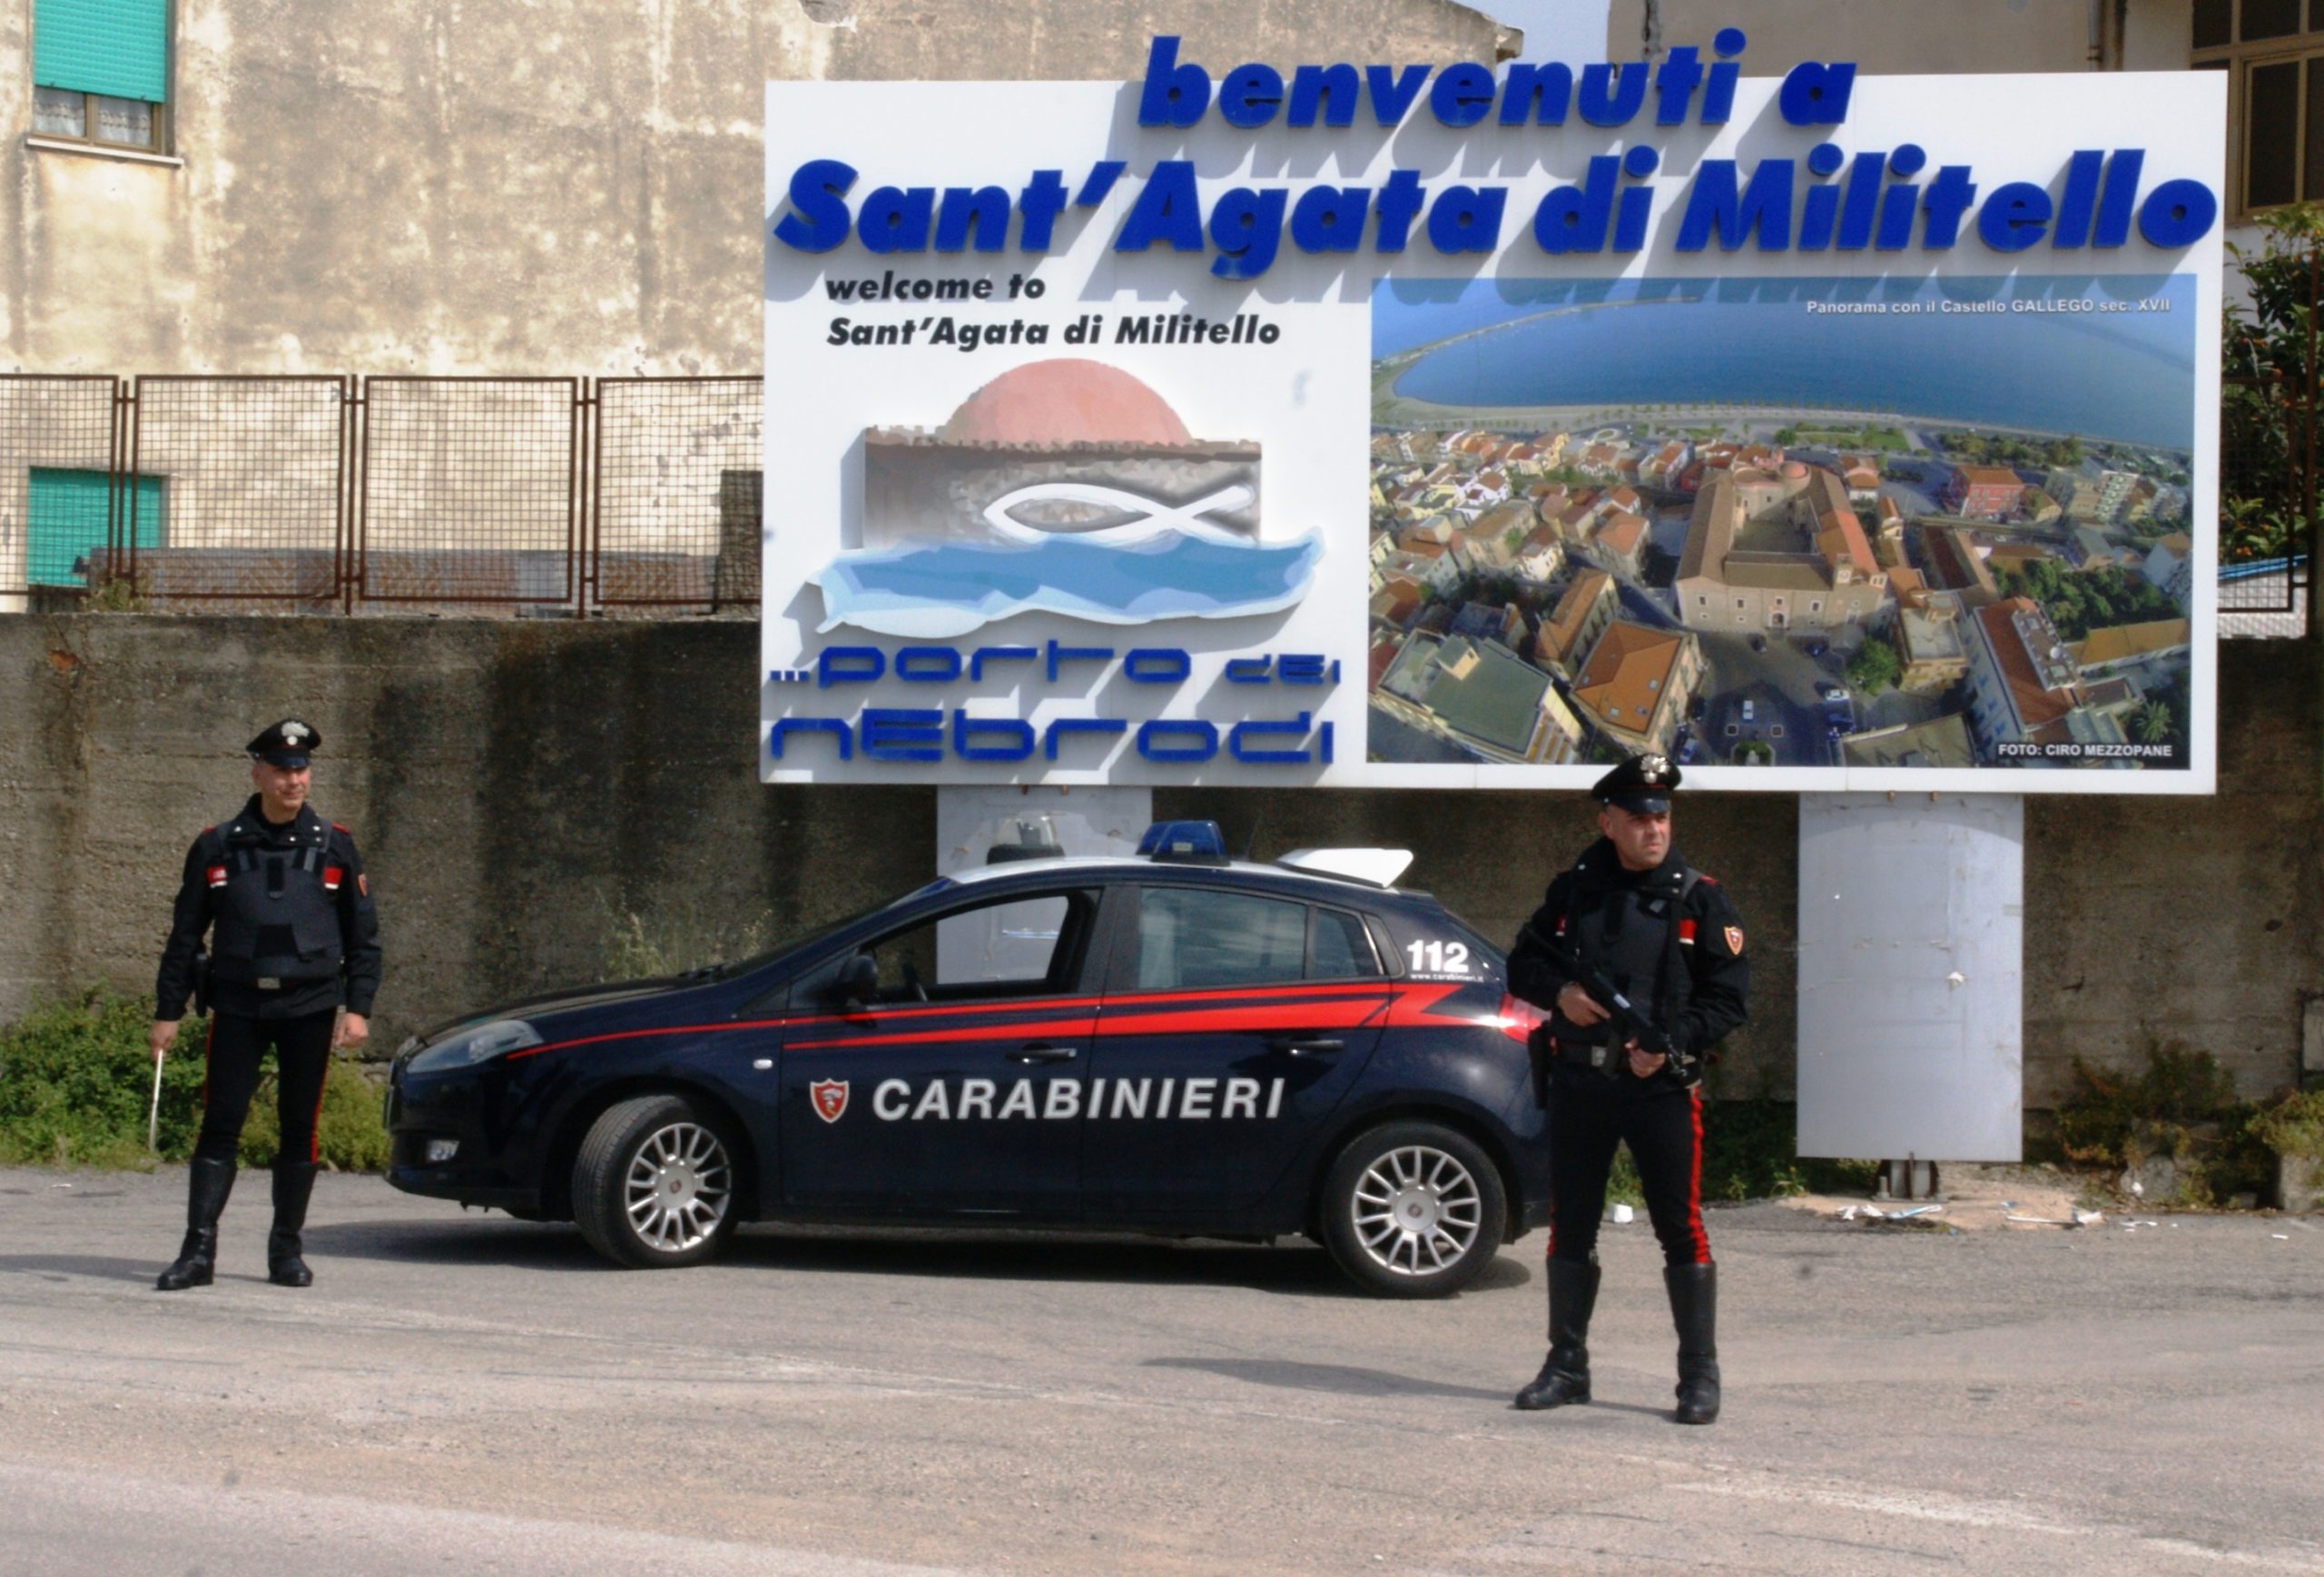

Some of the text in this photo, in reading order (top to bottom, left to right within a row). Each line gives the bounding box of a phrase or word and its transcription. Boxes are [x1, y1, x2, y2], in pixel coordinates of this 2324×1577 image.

[1137, 27, 1857, 129] benvenuti a
[773, 143, 2218, 280] Sant'Agata di Militello
[826, 270, 1046, 301] welcome to
[1807, 299, 2171, 313] Panorama con il Castello GALLEGO sec. XVII
[826, 314, 1281, 353] Sant'Agata di Militello
[1998, 744, 2173, 757] FOTO: CIRO MEZZOPANE
[1406, 939, 1470, 973] 112
[872, 1078, 1285, 1121] CARABINIERI
